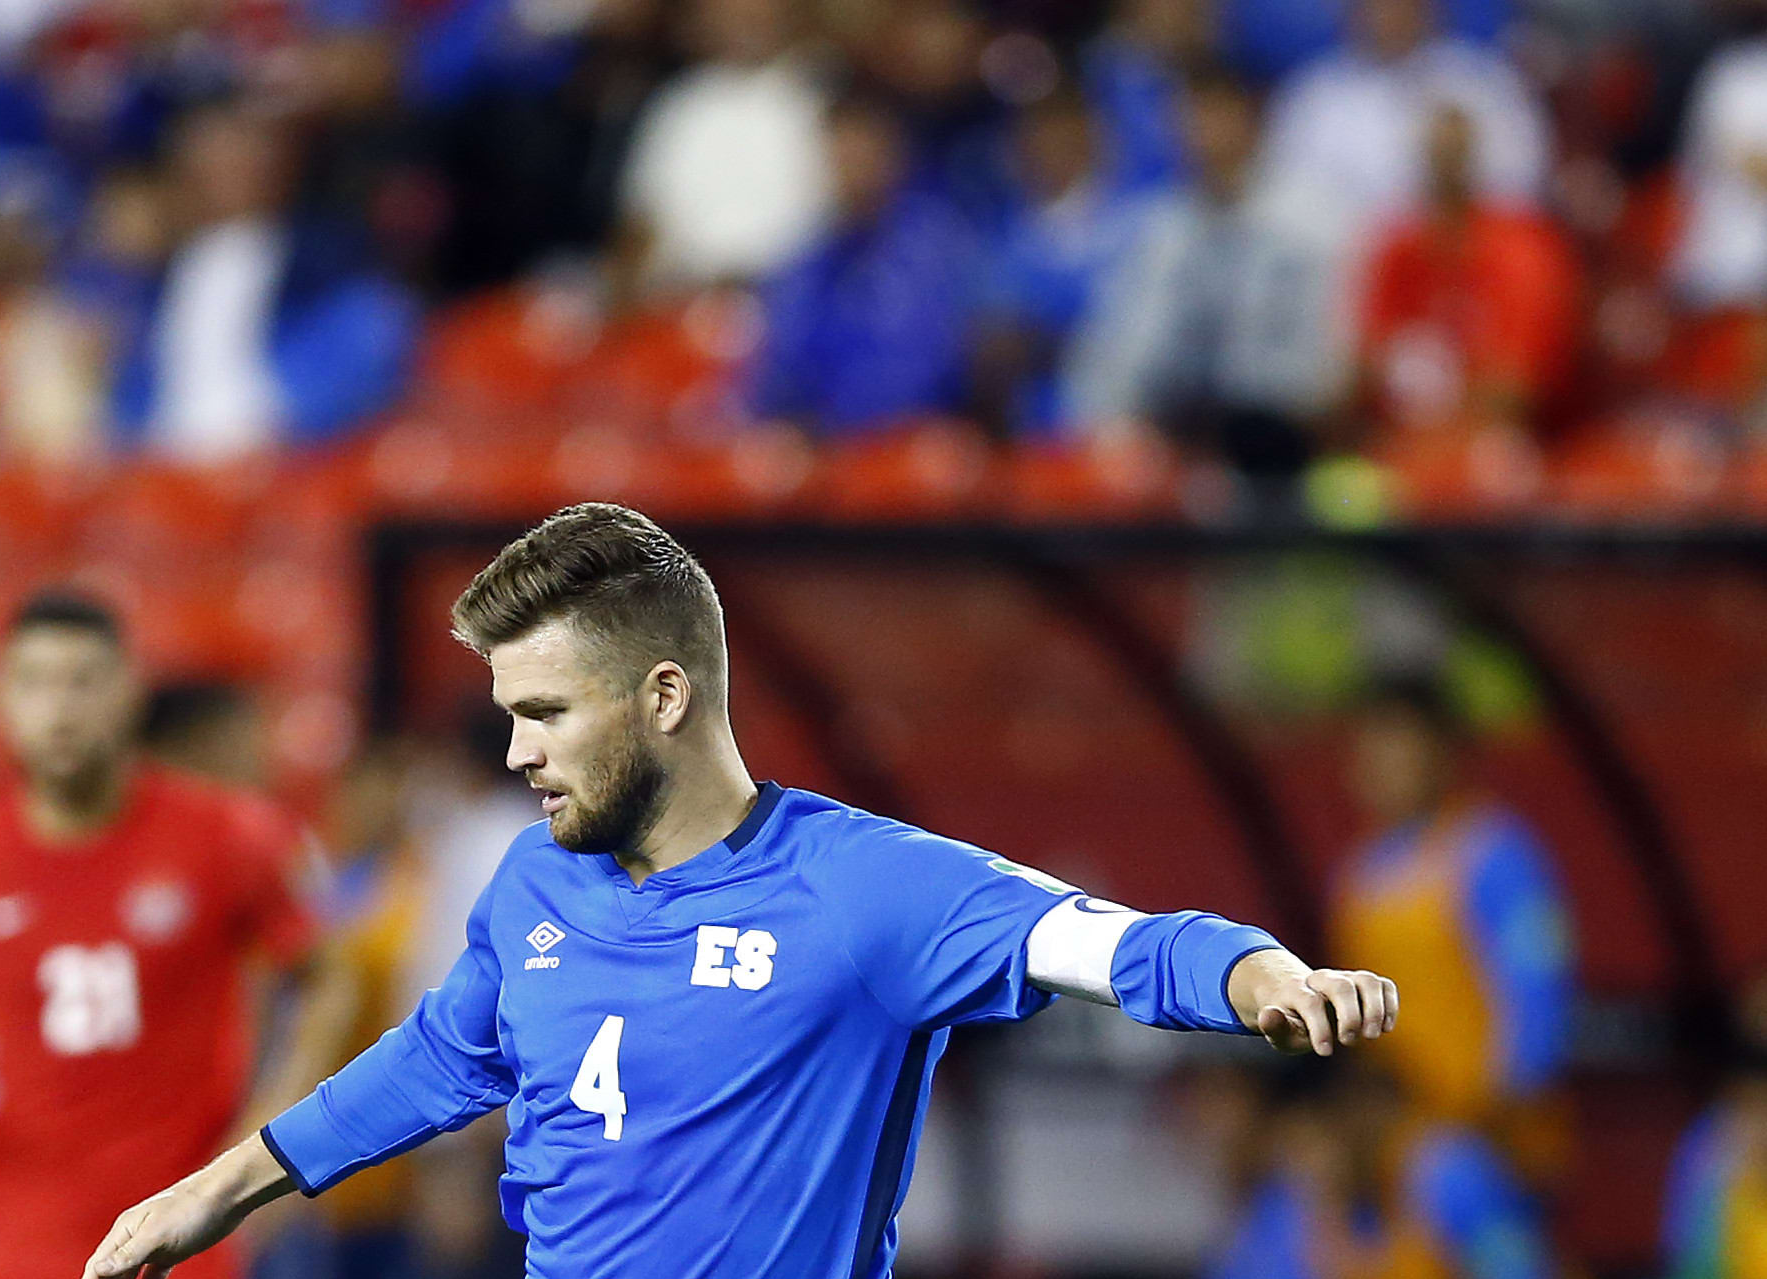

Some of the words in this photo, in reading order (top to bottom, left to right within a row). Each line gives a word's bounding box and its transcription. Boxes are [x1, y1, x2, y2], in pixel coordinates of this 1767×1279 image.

[524, 953, 560, 971] umbro
[690, 924, 778, 991] ES
[569, 1014, 627, 1142] 4
